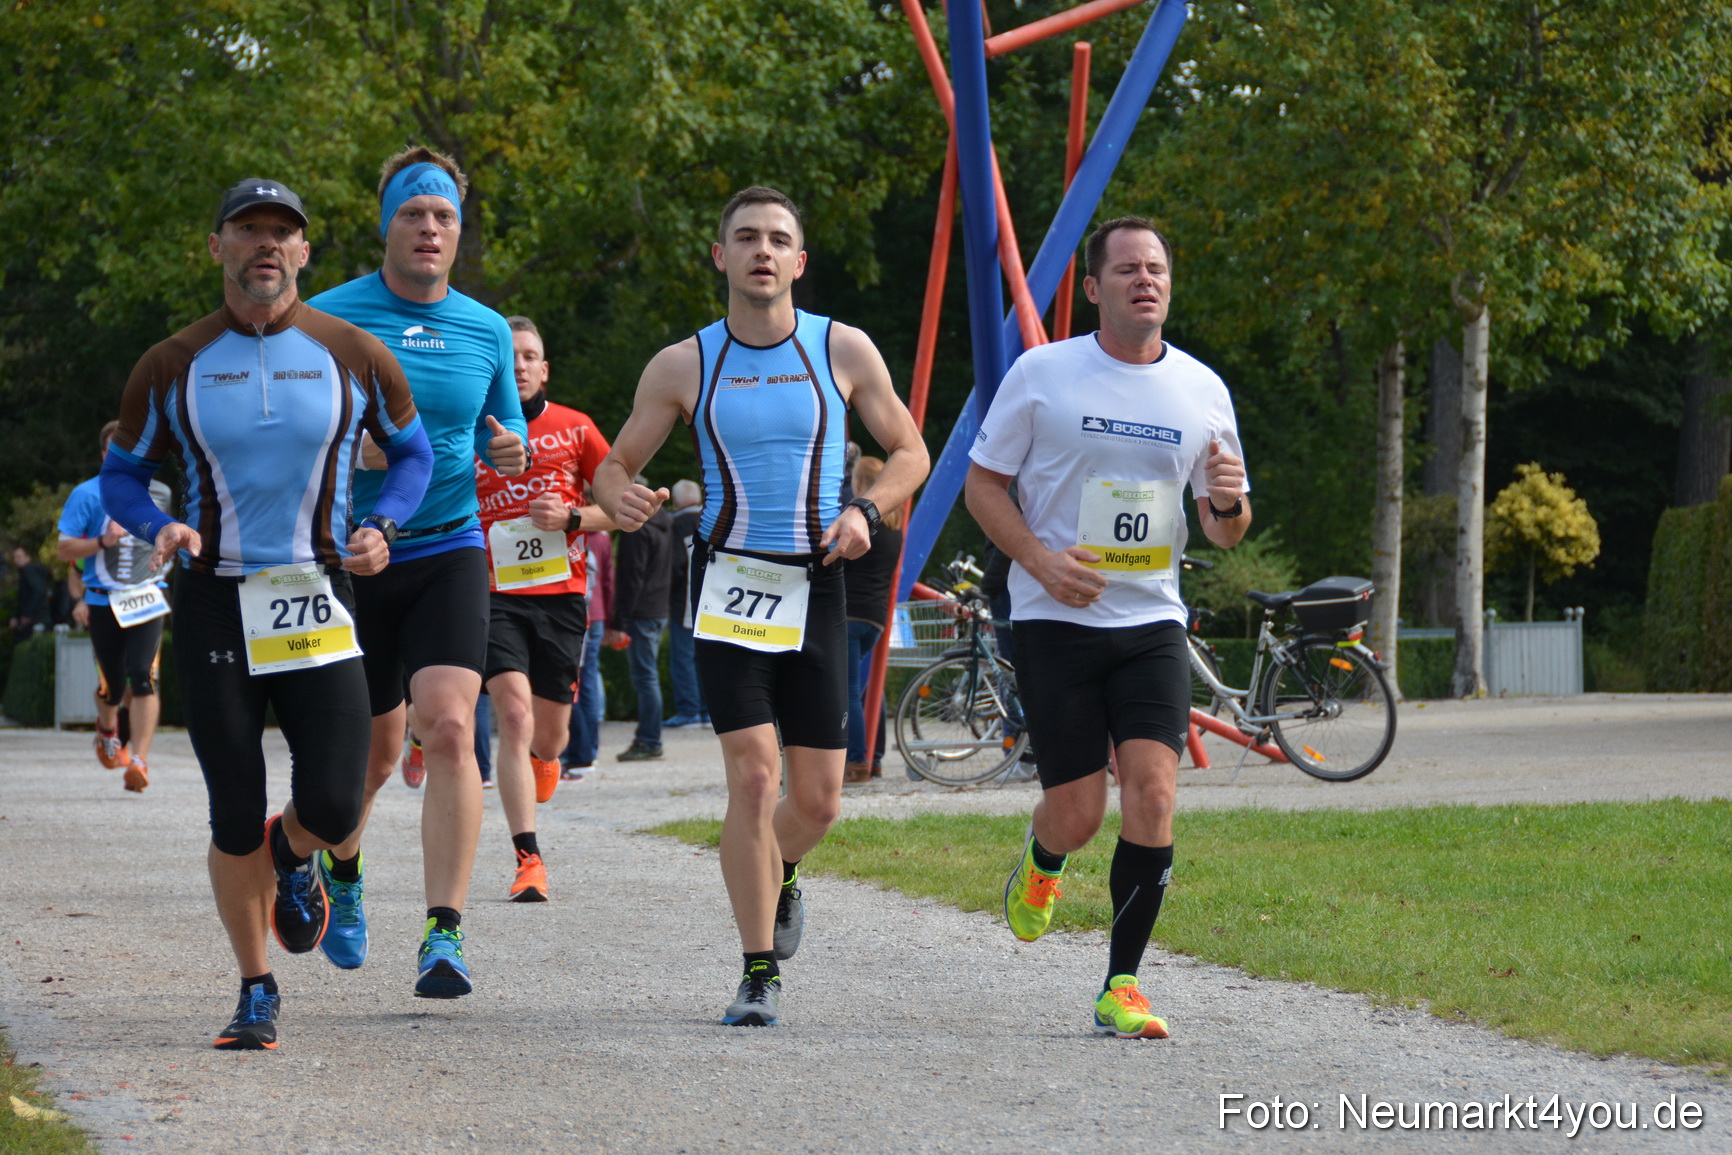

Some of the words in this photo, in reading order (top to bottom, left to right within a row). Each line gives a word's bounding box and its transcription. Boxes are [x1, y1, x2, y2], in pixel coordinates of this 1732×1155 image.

[402, 337, 446, 349] skinfit
[273, 371, 286, 381] BIO
[299, 370, 323, 380] RACER
[790, 373, 810, 382] RACER
[1112, 421, 1179, 442] BÜSCHEL
[1122, 490, 1155, 500] BOCK
[1113, 512, 1149, 542] 60
[515, 537, 543, 560] 28
[1105, 551, 1151, 566] Wolfgang
[283, 571, 321, 584] BOCK
[520, 565, 544, 576] Tobias
[746, 566, 782, 582] BOCK
[119, 592, 155, 612] 2070
[724, 586, 782, 620] 277
[270, 593, 331, 630] 276
[733, 624, 766, 637] Daniel
[287, 637, 322, 651] Volker
